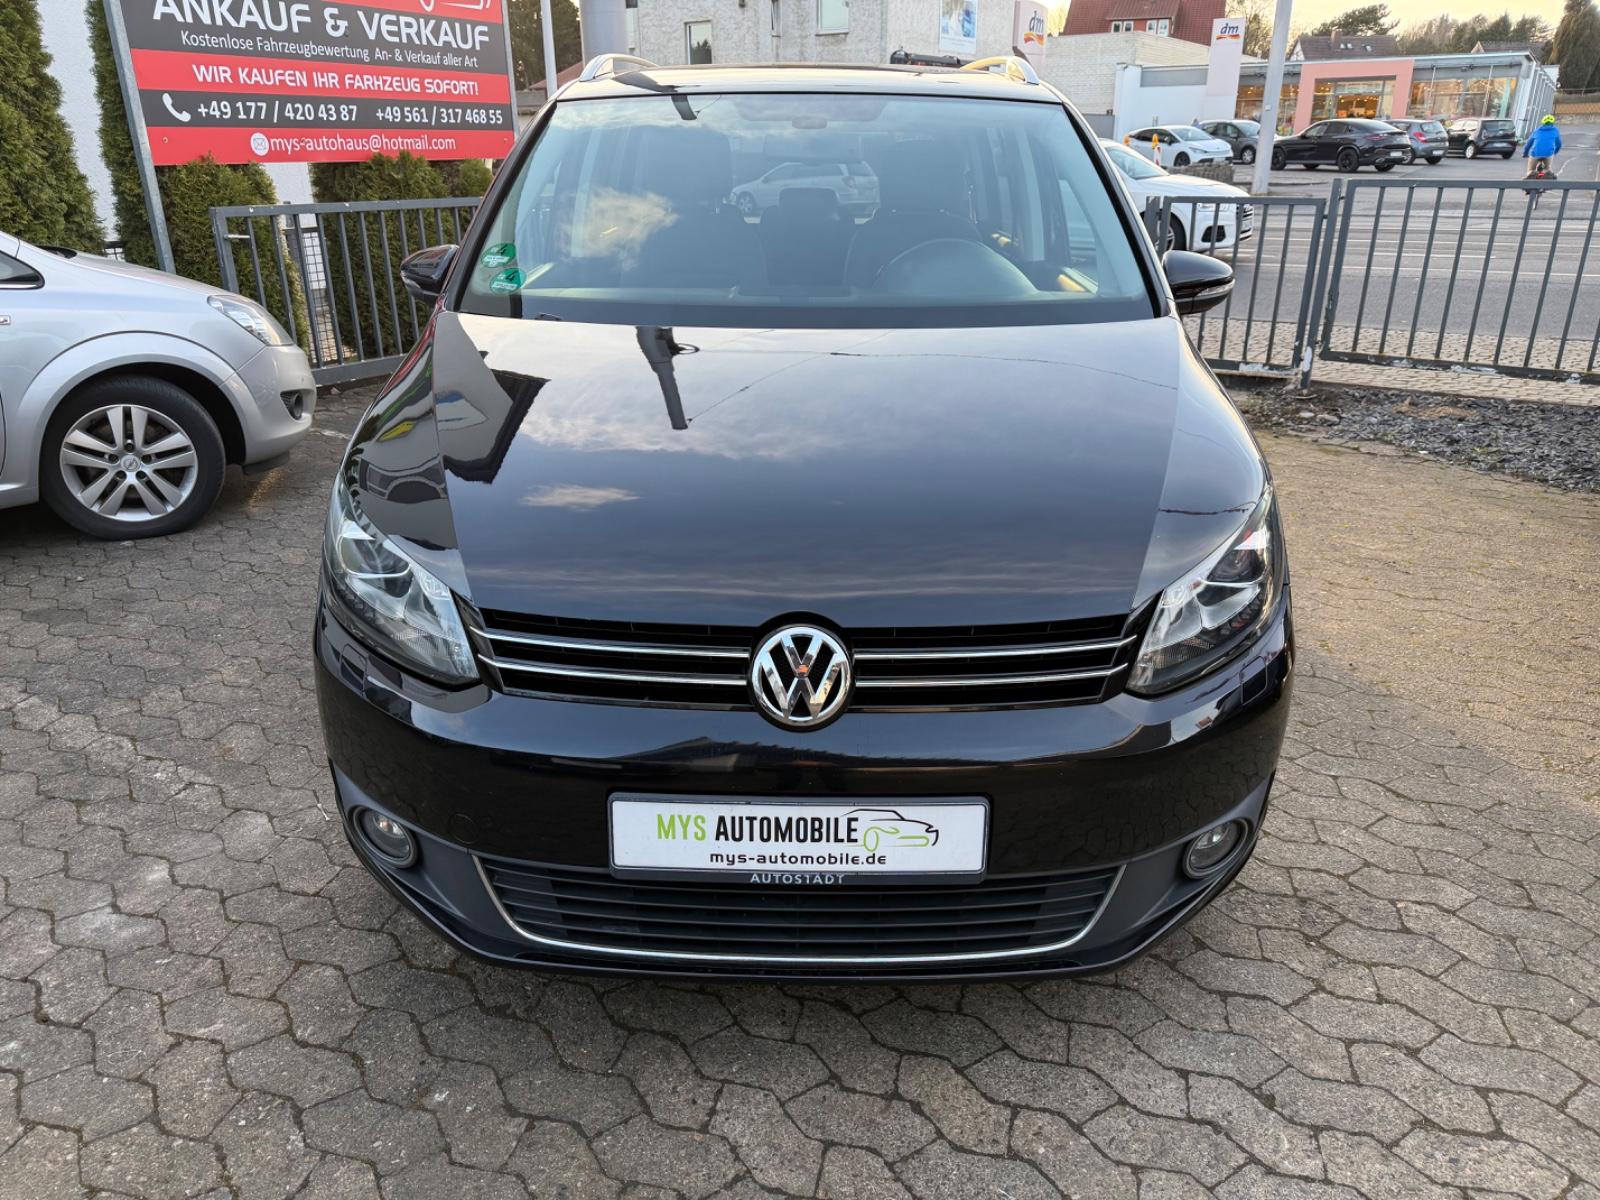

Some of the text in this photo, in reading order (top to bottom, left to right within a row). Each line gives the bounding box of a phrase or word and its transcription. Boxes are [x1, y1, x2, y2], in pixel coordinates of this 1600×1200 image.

[153, 0, 489, 50] ANKAUF & VERKAUF
[1029, 10, 1043, 33] dm
[1220, 22, 1239, 34] dm
[181, 30, 478, 68] Kostenlose Fahrzeugbewertung An- & Verkauf aller Art
[192, 64, 479, 95] WIR KAUFEN IHR FARHZEUG SOFORT!
[198, 100, 232, 119] +49
[236, 101, 267, 119] 177
[284, 103, 315, 120] 420
[318, 104, 337, 120] 43
[340, 105, 357, 120] 87
[376, 106, 400, 122] +49
[404, 107, 428, 123] 561
[440, 108, 462, 123] 317
[465, 109, 487, 124] 468
[489, 110, 503, 124] 55
[270, 133, 456, 154] mys-autohaus@hotmail.com
[656, 814, 858, 843] MYS AUTOMOBILE
[709, 851, 887, 866] mys-automobile.de
[750, 873, 845, 885] AUTOSTADT
